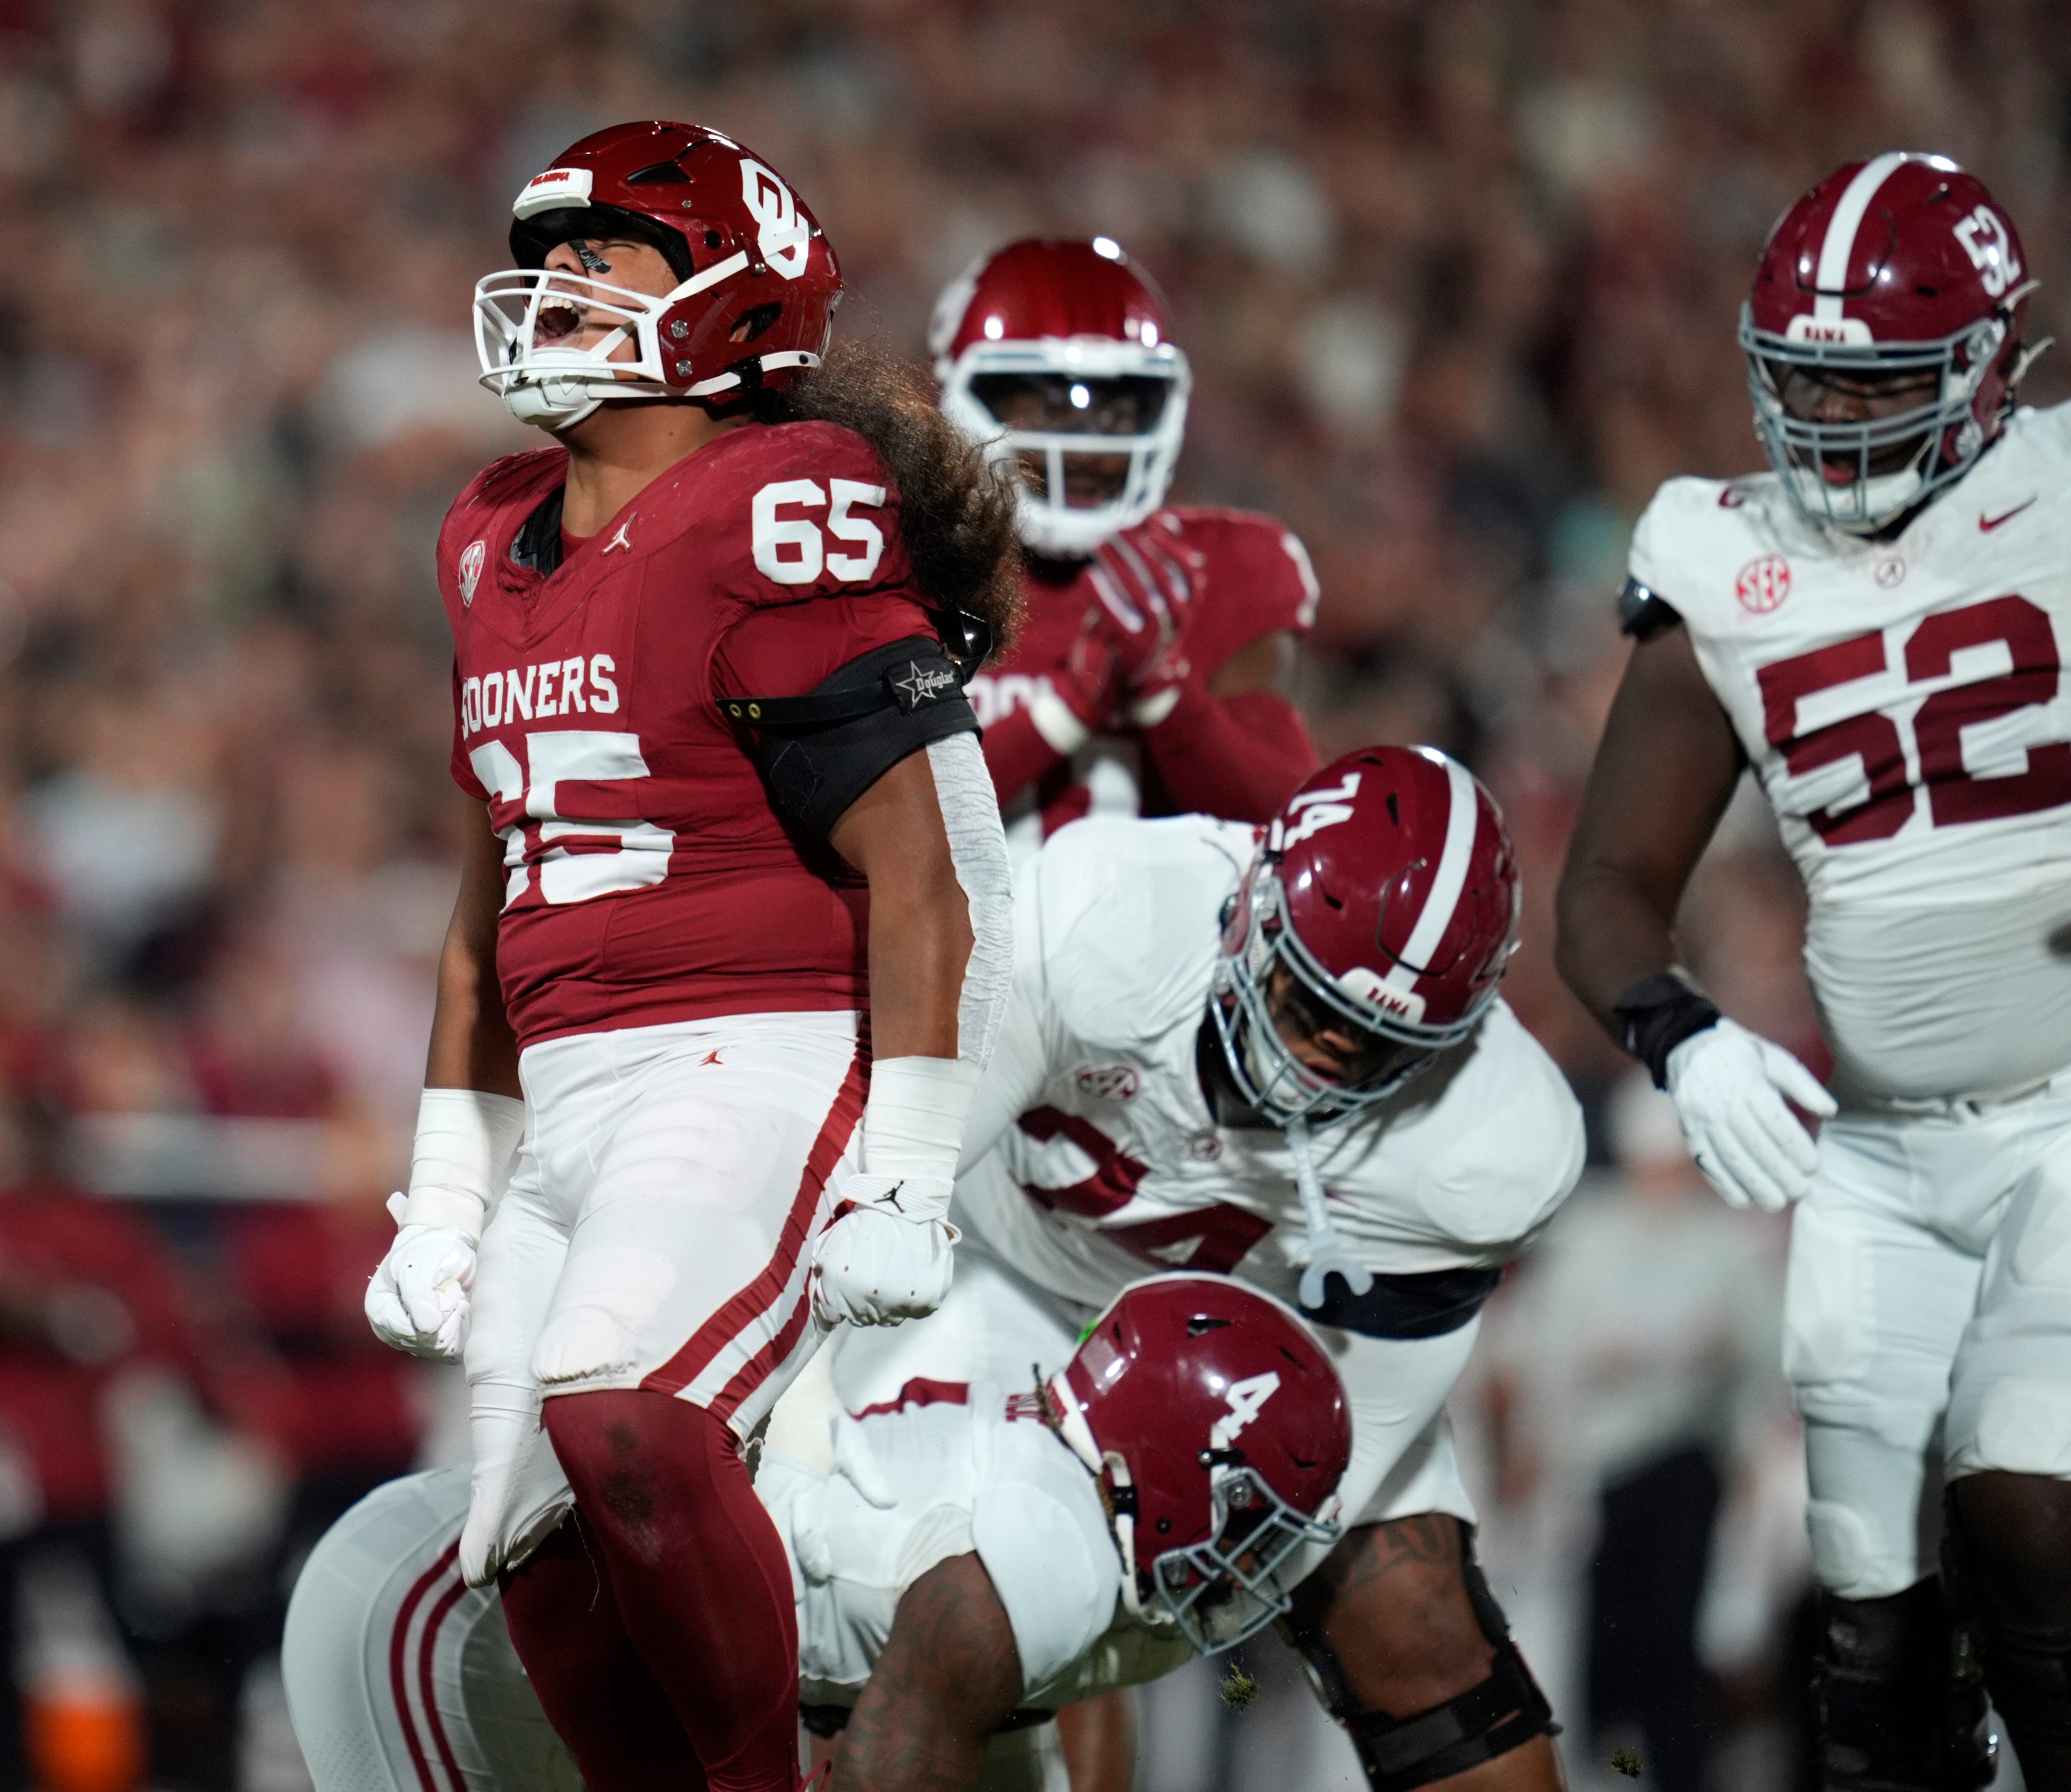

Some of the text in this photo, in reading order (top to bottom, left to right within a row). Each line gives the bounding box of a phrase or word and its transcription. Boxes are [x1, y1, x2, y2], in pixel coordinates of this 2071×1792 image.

[1953, 205, 2021, 297] 52
[751, 478, 886, 585] 65
[915, 671, 954, 691] Douglas
[1757, 594, 2071, 847] 52
[1281, 772, 1362, 850] 74
[1216, 1371, 1281, 1440] 4
